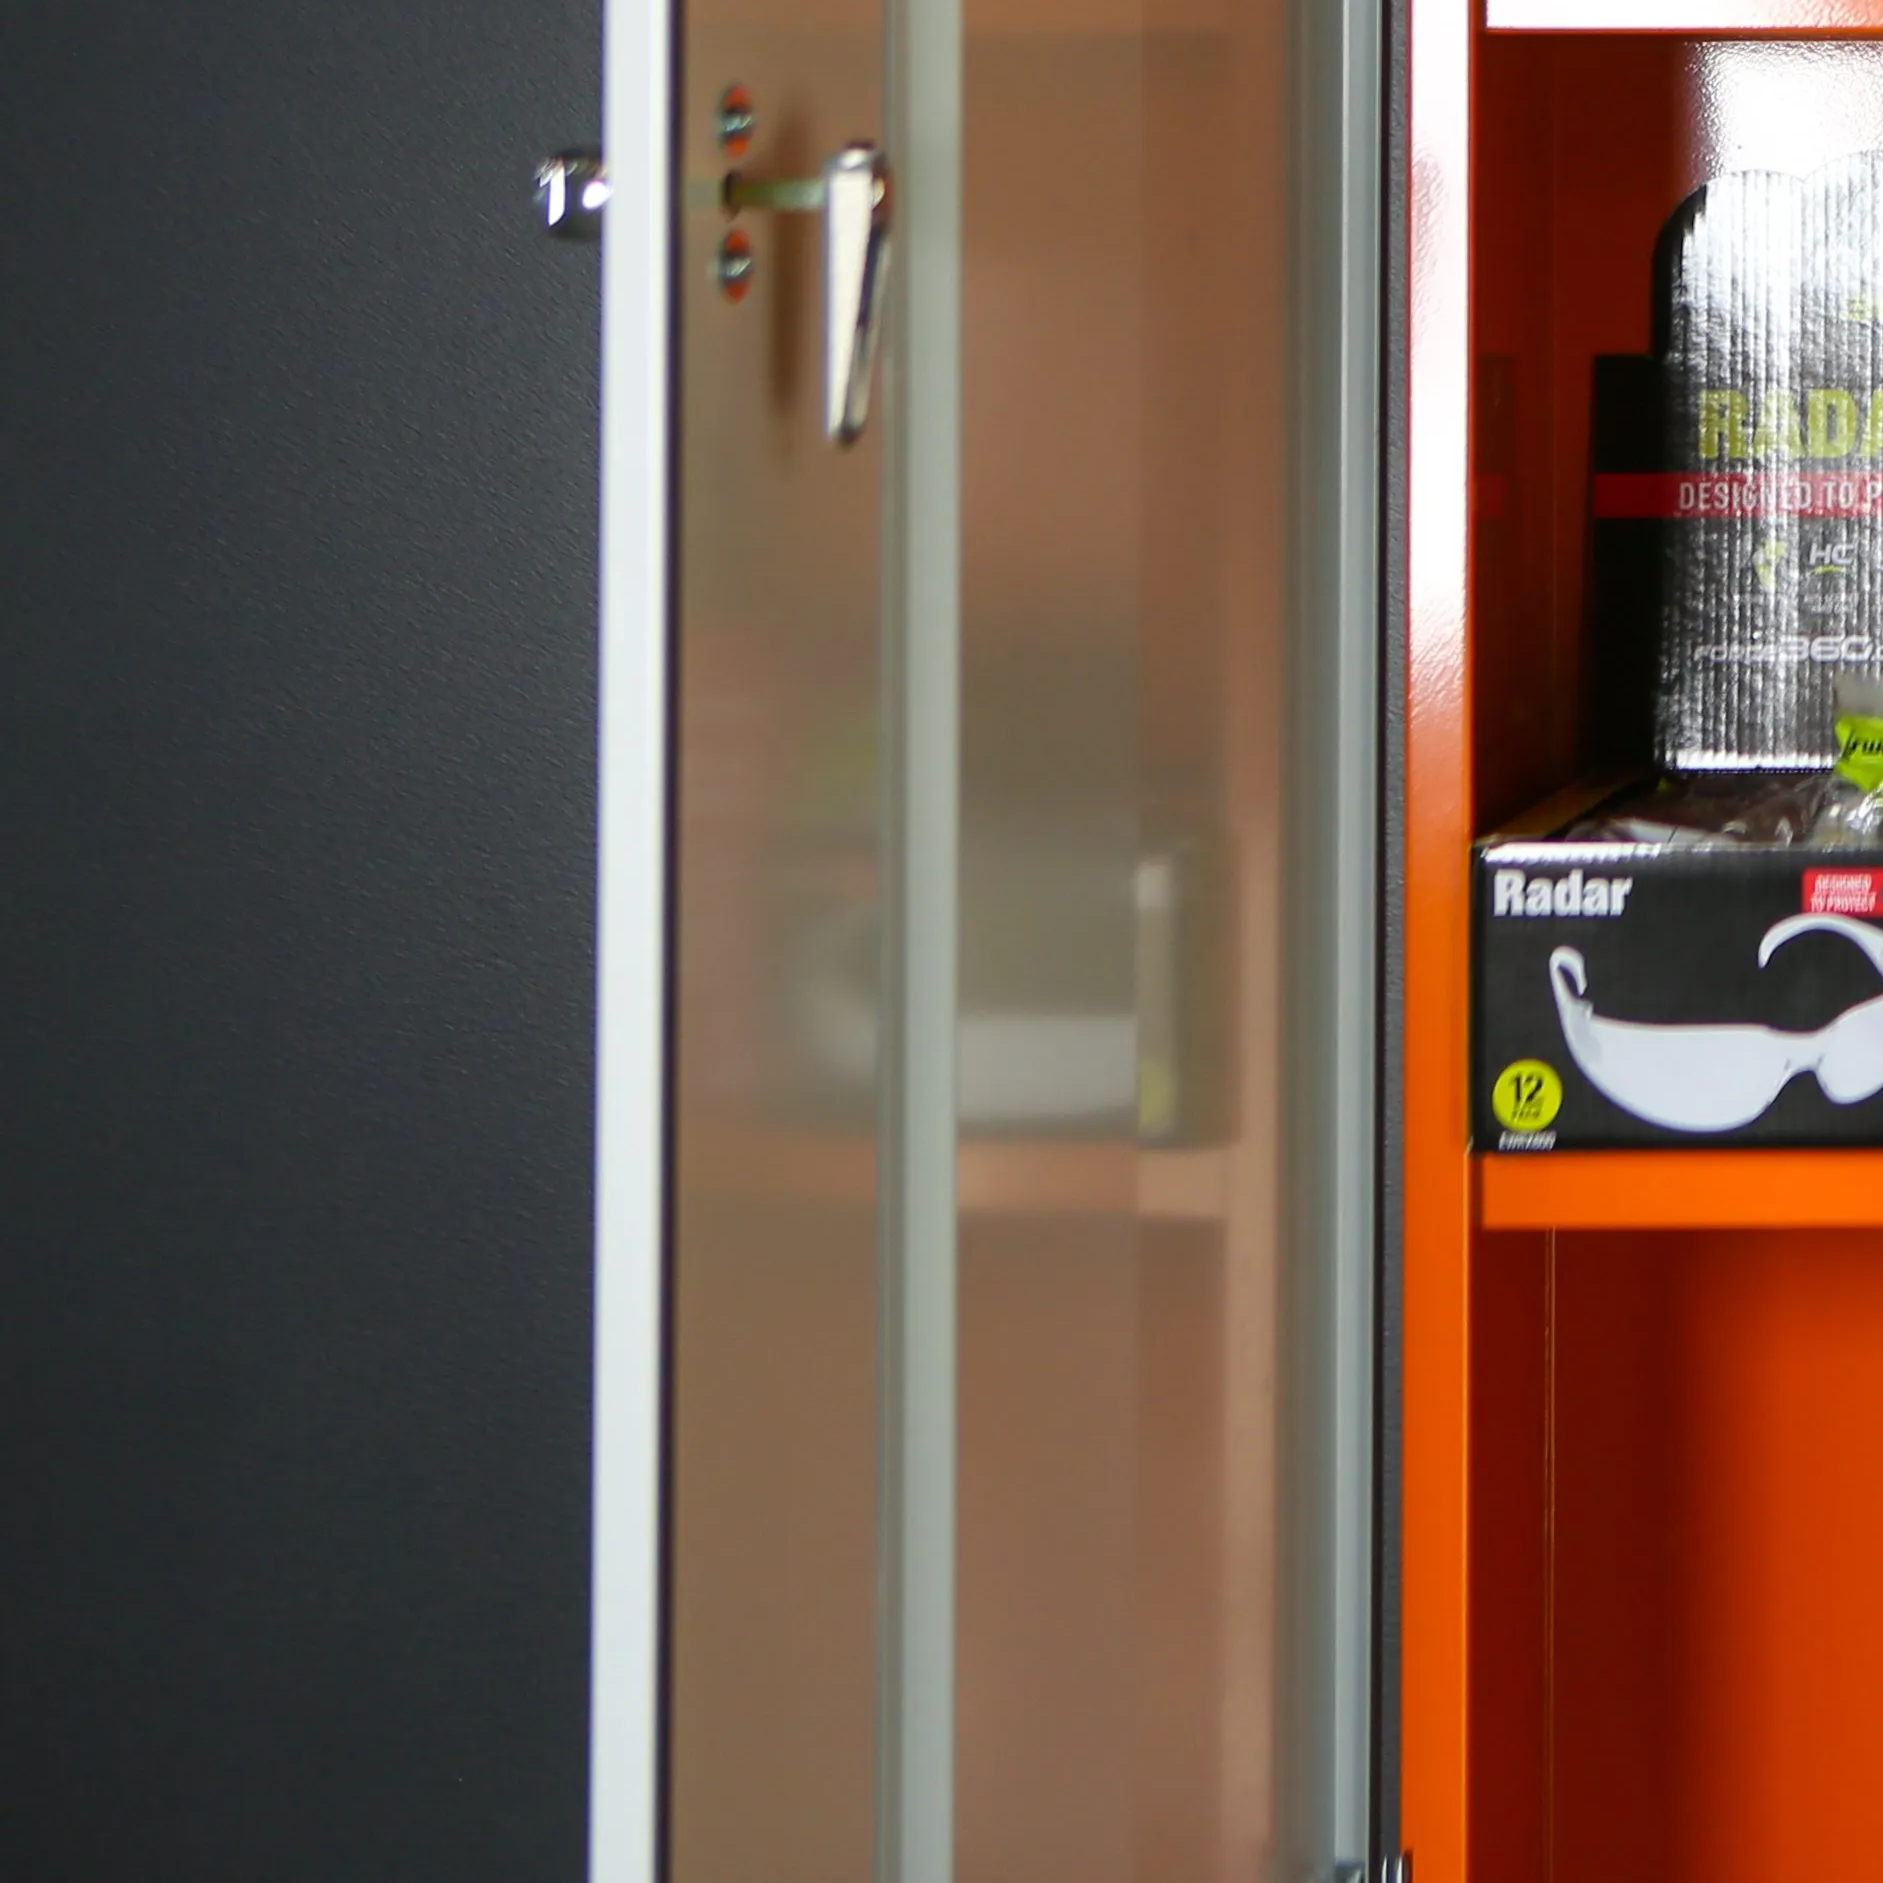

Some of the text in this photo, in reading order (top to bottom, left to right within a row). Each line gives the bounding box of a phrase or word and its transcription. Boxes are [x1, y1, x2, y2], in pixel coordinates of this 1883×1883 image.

[1679, 480, 1812, 511] DESIGNED
[1822, 480, 1855, 510] TO
[1493, 868, 1634, 917] Radar
[1507, 1072, 1544, 1102] 12
